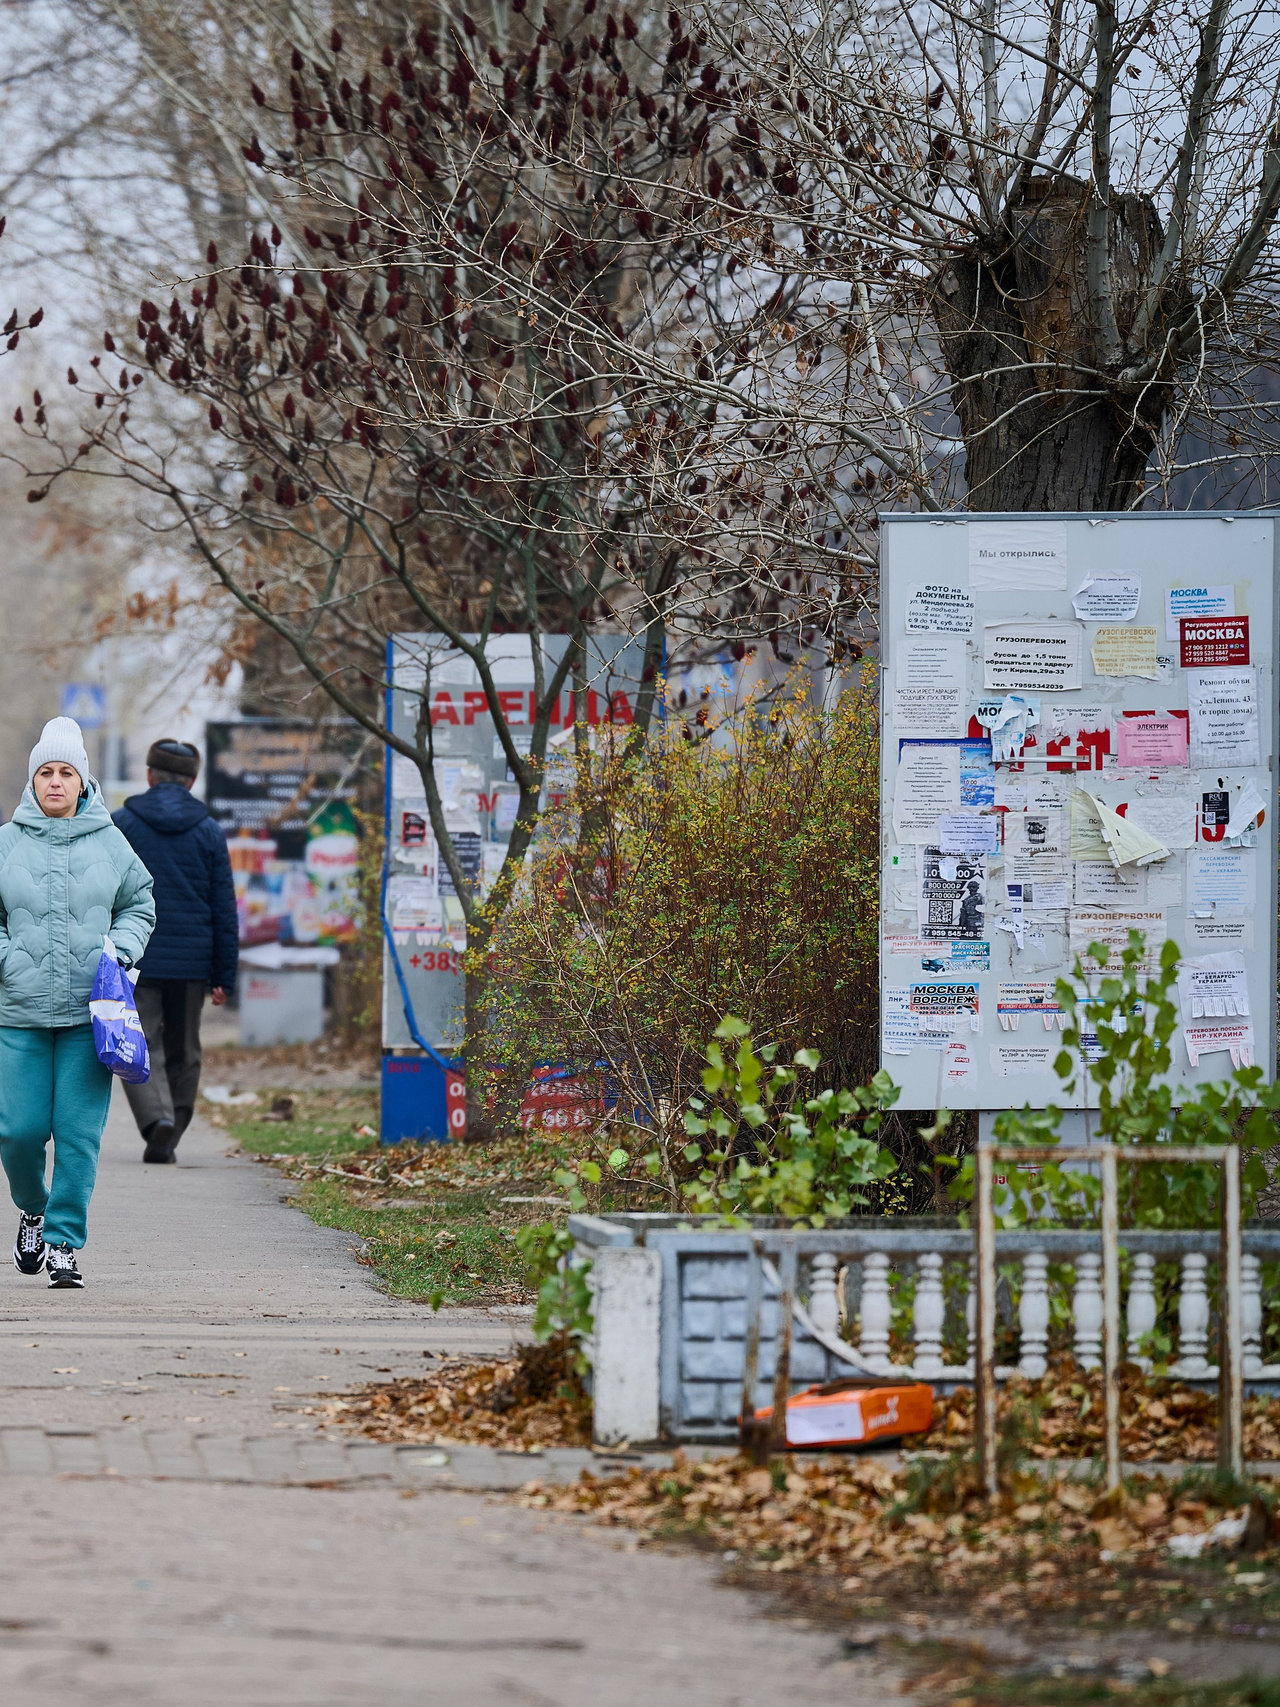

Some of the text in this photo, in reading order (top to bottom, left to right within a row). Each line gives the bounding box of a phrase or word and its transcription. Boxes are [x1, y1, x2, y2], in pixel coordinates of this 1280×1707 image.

[979, 550, 1056, 559] Мы открылись
[916, 592, 969, 600] ДОКУМЕНТЫ
[1171, 588, 1208, 597] МОСКВА
[1185, 628, 1244, 640] МОСКВА
[996, 637, 1066, 645] ГРУЗОПЕРЕВОЗКИ
[1229, 678, 1250, 686] обуви
[914, 985, 975, 994] МОСКВА
[913, 996, 975, 1004] ВОРОНЕЖ
